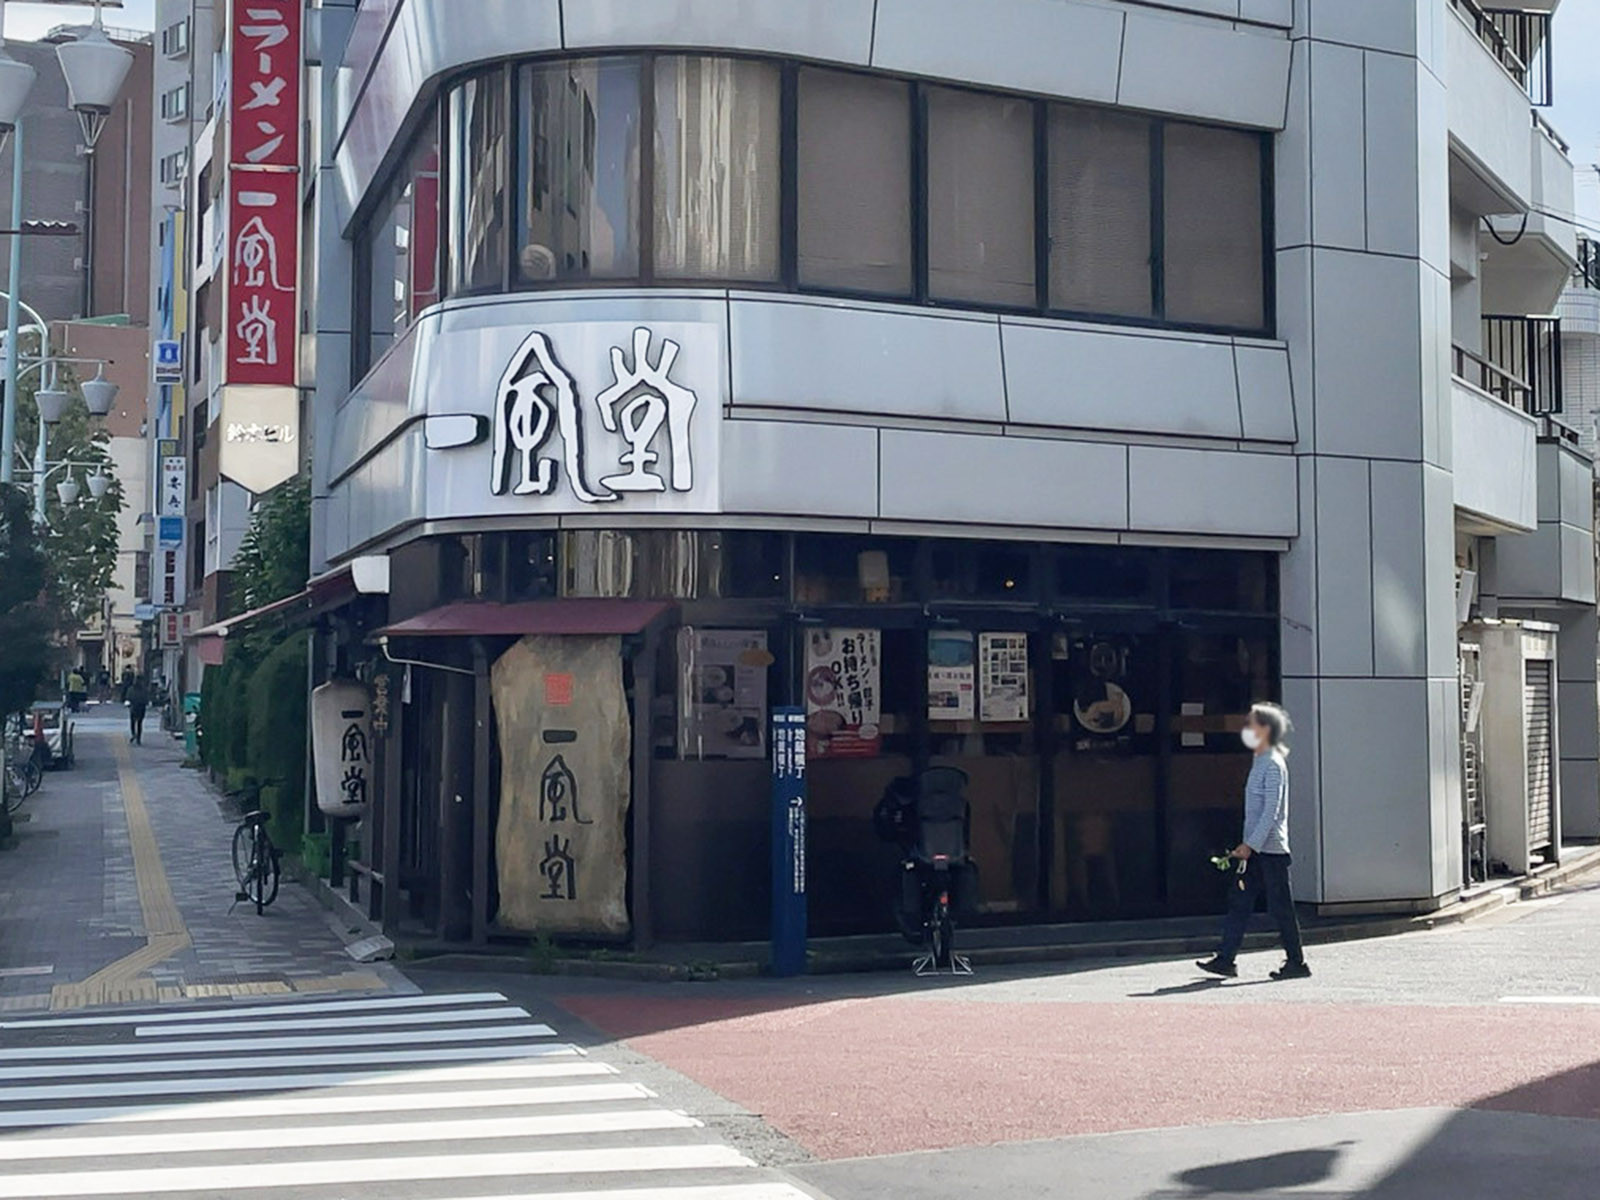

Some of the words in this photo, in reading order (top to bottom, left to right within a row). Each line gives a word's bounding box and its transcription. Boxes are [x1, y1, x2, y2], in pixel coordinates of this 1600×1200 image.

[239, 8, 290, 163] ラーメン
[234, 190, 295, 365] 一風堂
[424, 326, 697, 503] 一風堂
[341, 709, 371, 803] 一風堂
[372, 674, 390, 738] 営業中
[841, 638, 863, 726] お持ち帰り
[540, 728, 594, 900] 一風堂
